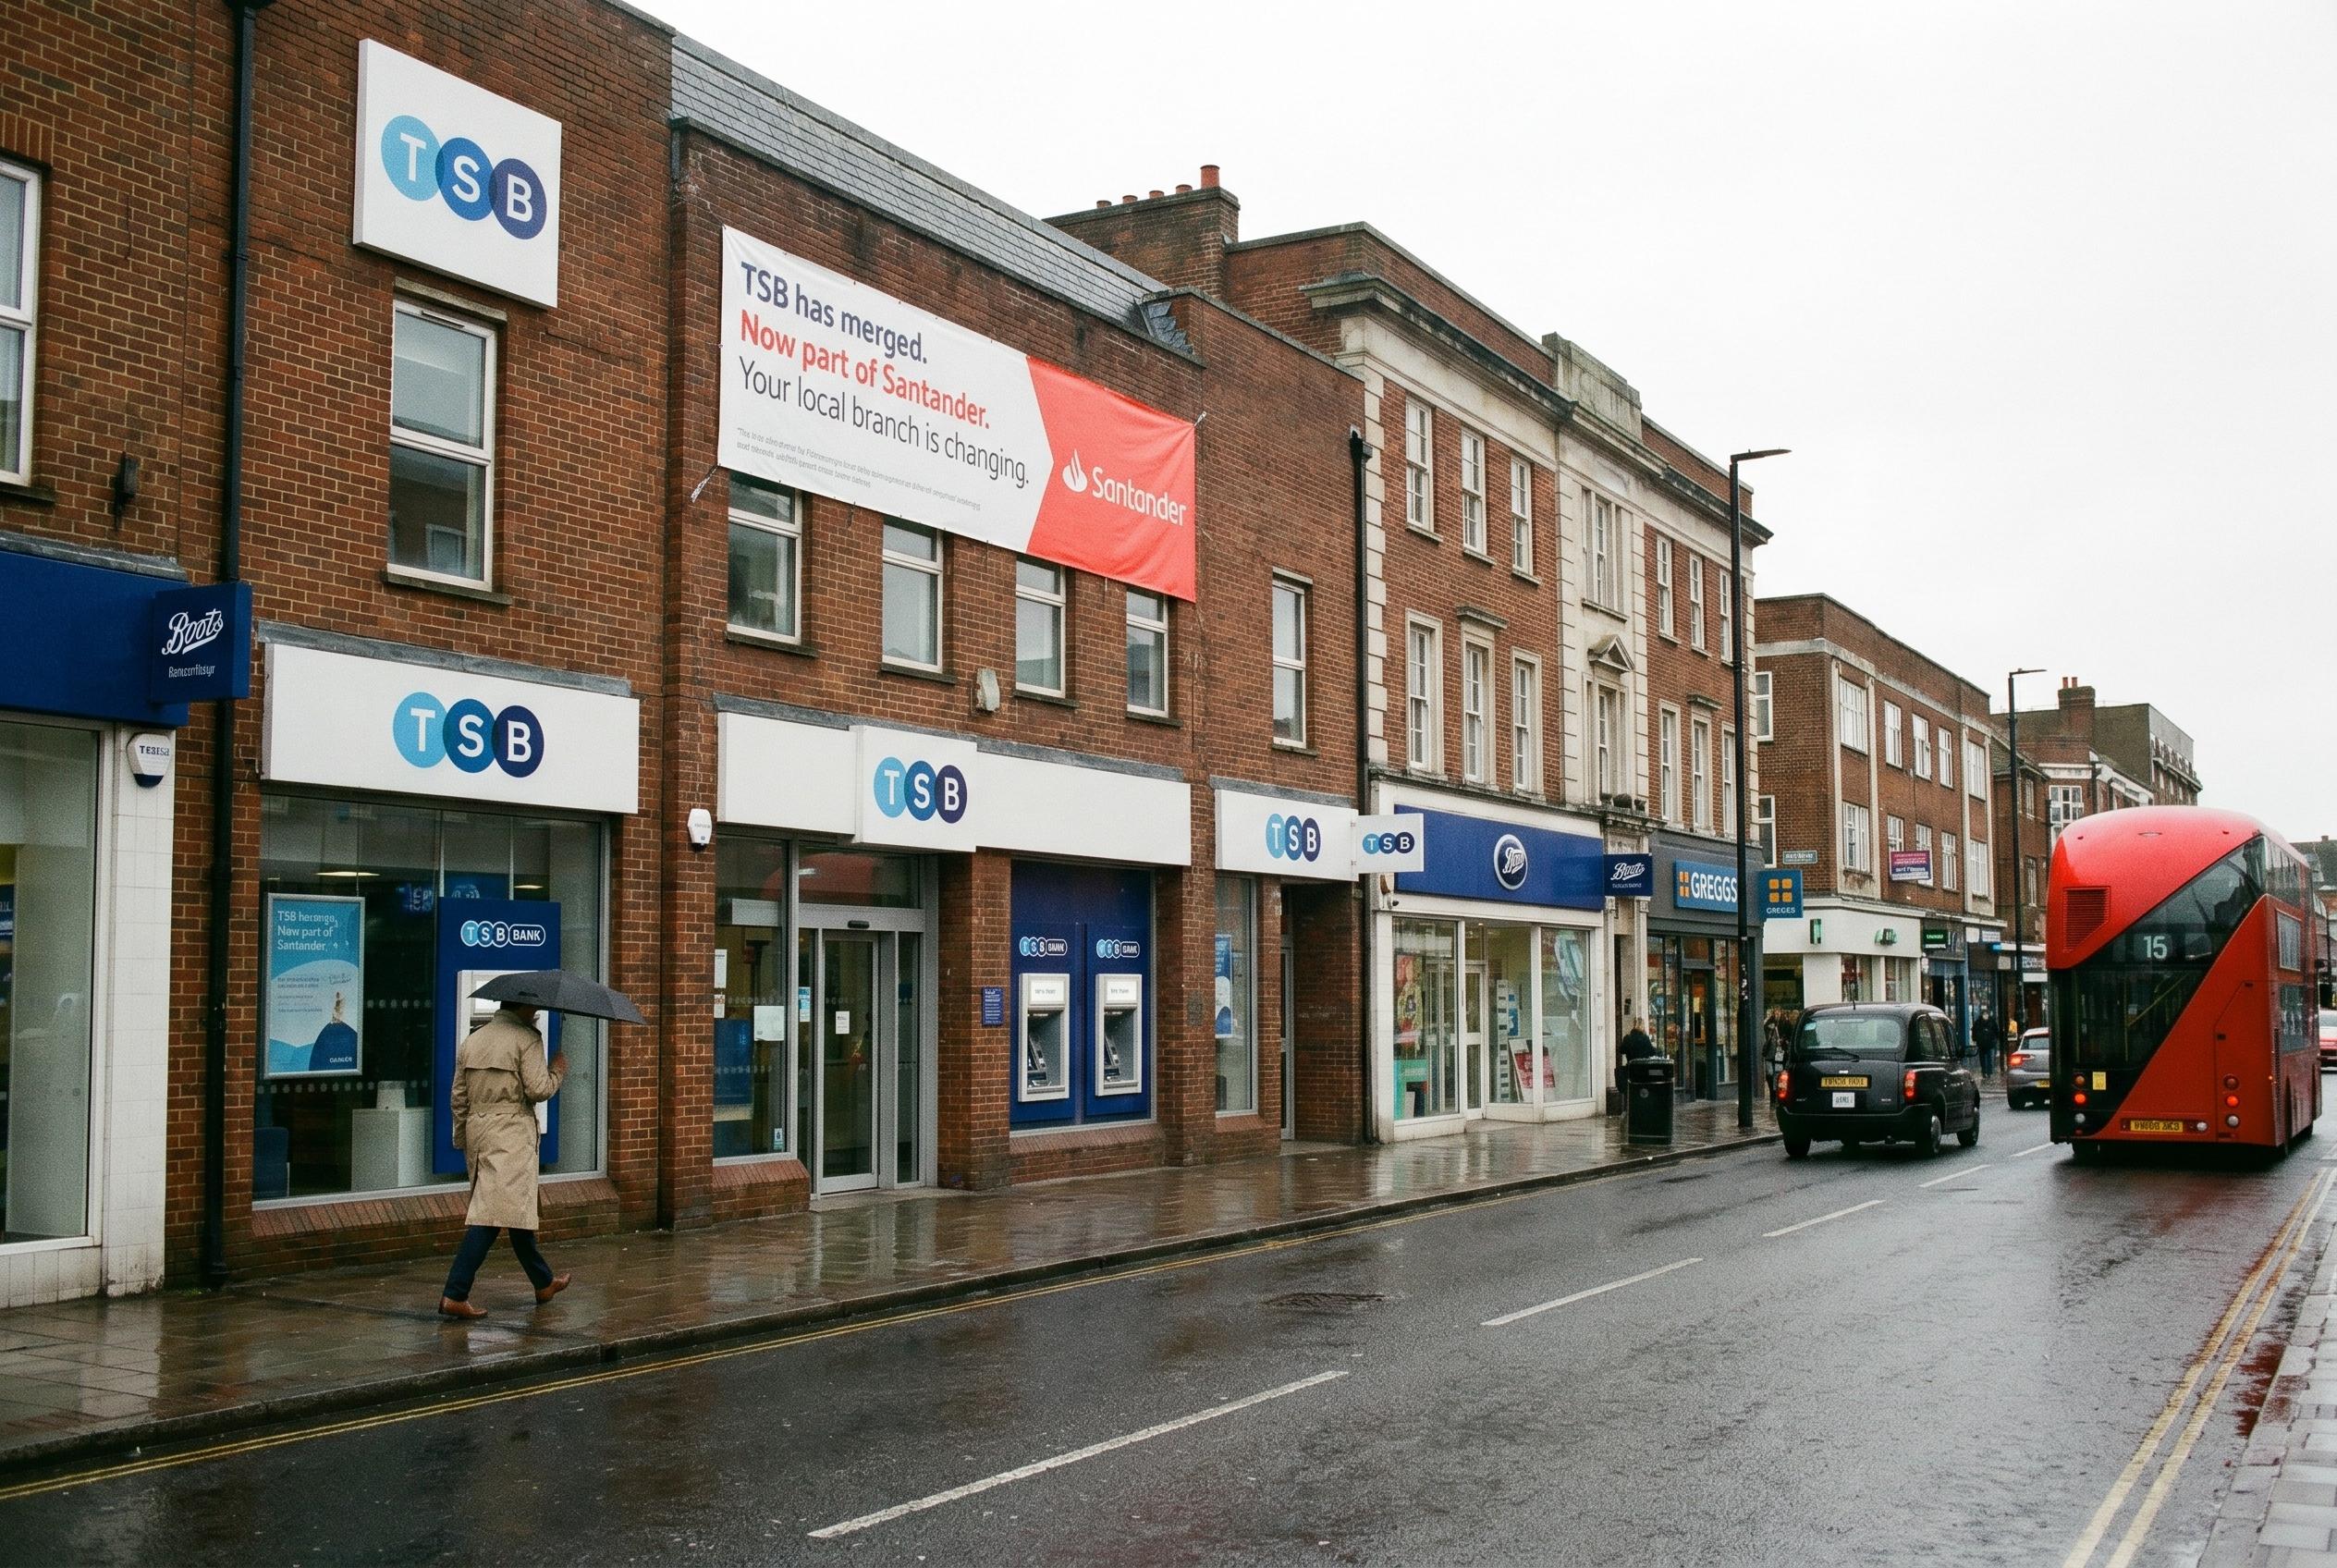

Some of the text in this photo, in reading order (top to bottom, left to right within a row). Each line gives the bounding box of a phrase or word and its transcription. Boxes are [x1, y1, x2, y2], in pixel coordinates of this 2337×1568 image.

[398, 130, 534, 224] TSB
[740, 261, 928, 364] TSB has merged.
[740, 309, 990, 430] Now part of Santander.
[739, 355, 791, 403] Your
[798, 375, 845, 423] local
[852, 395, 919, 447] branch
[925, 422, 939, 454] is
[944, 431, 1030, 489] changing.
[1092, 465, 1187, 527] Santander
[161, 608, 224, 655] Boots
[409, 705, 533, 765] TSB
[883, 767, 961, 814] TSB
[1270, 821, 1318, 854] TSB
[1366, 836, 1412, 851] TSB
[1690, 871, 1738, 903] GREGGS
[277, 910, 297, 922] TSB
[301, 927, 321, 939] part
[323, 926, 334, 937] of
[466, 925, 542, 942] TSB BANK
[2143, 935, 2168, 960] 15
